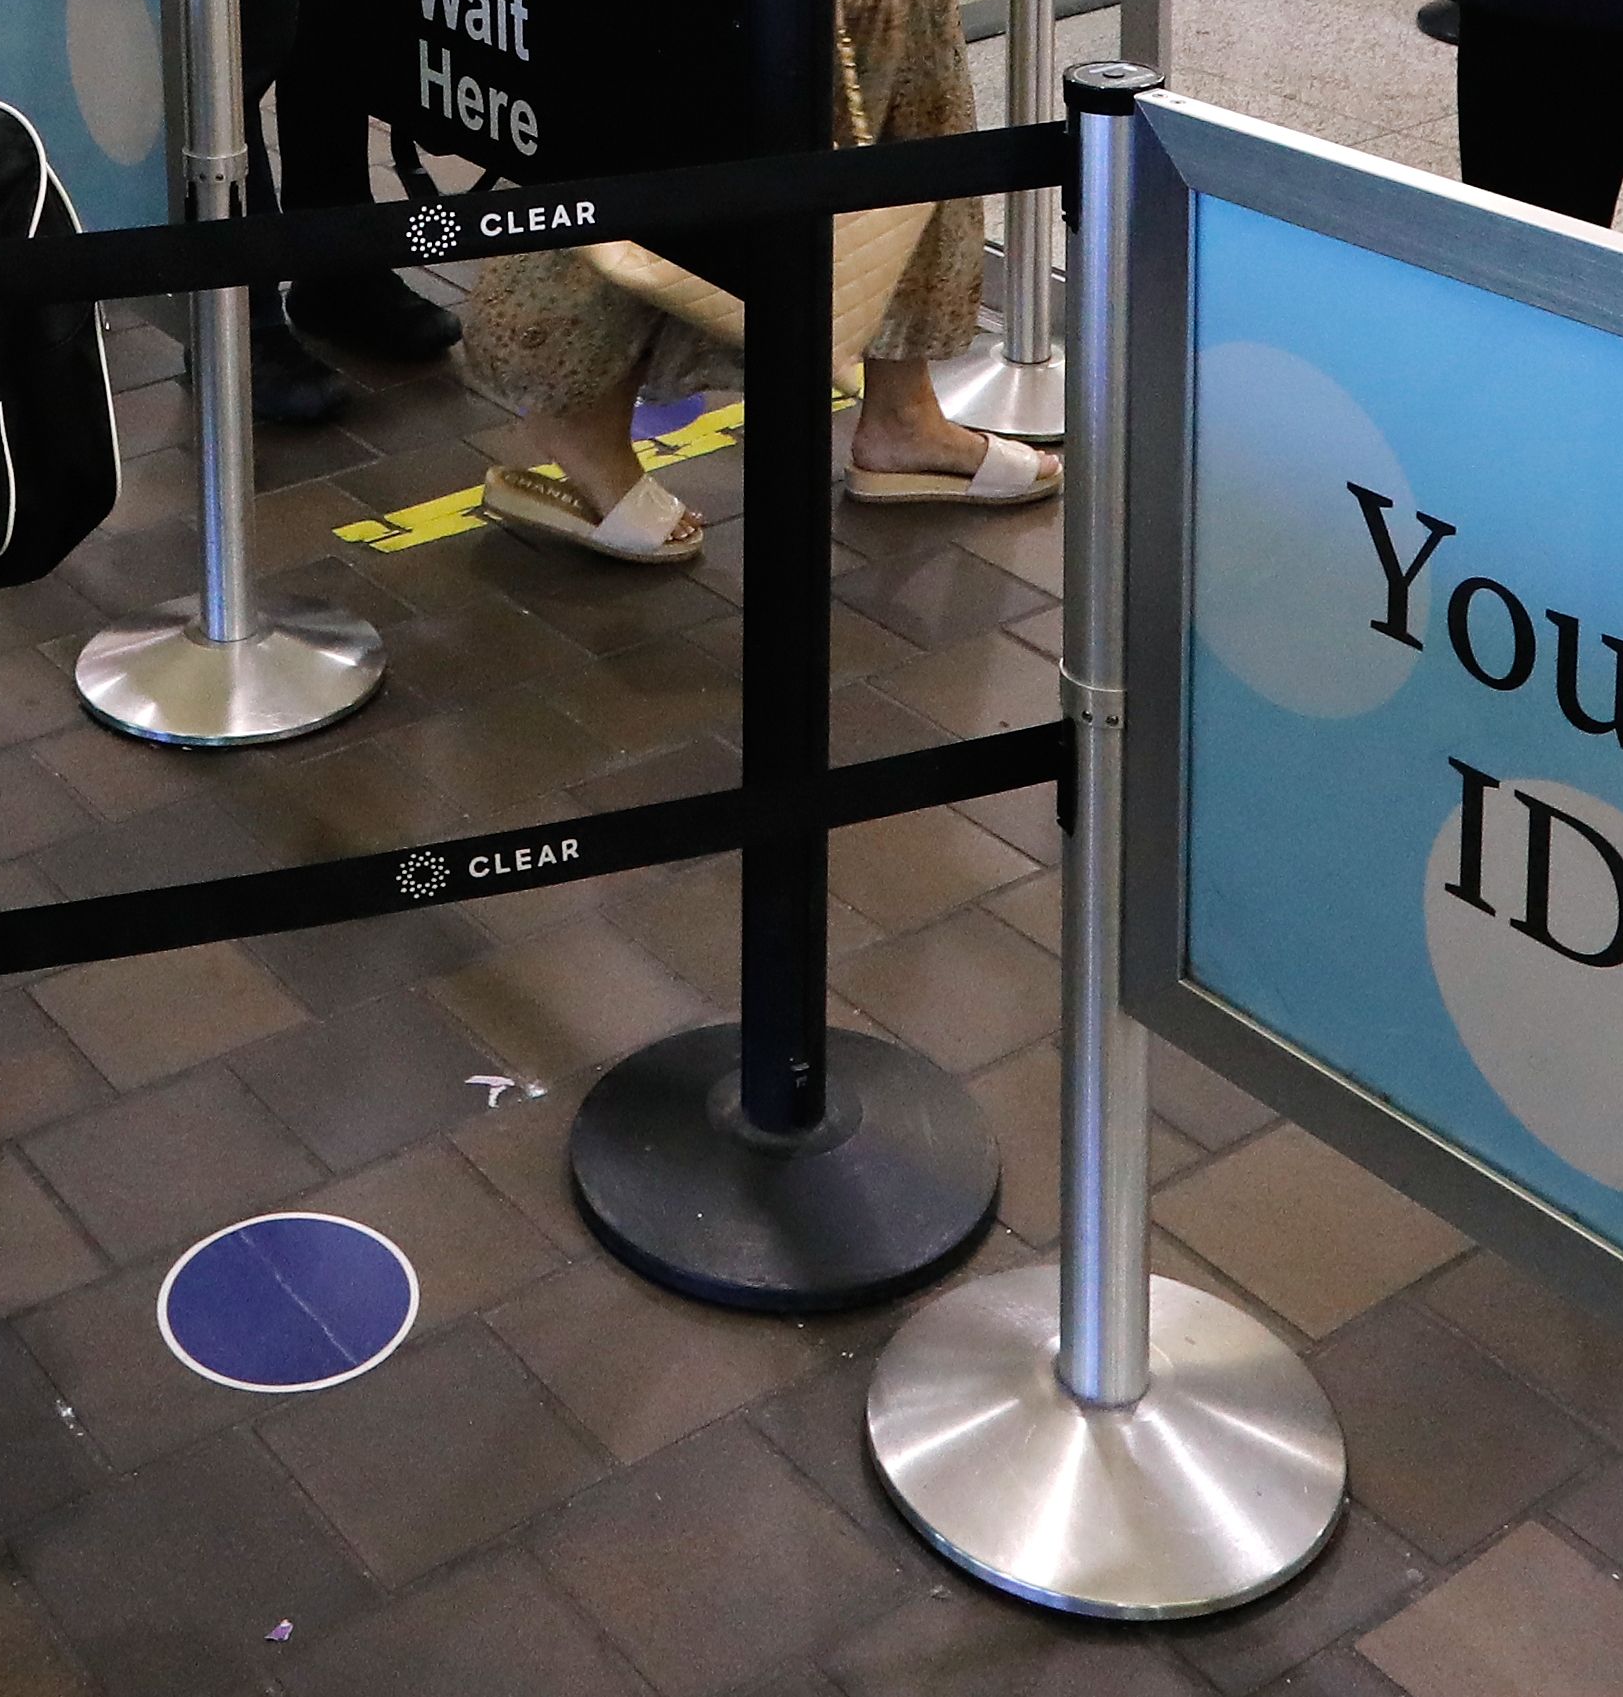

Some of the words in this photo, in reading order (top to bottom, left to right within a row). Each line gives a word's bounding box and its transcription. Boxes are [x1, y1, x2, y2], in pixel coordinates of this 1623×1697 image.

[419, 38, 538, 157] Here
[480, 201, 596, 237] CLEAR
[468, 838, 580, 878] CLEAR
